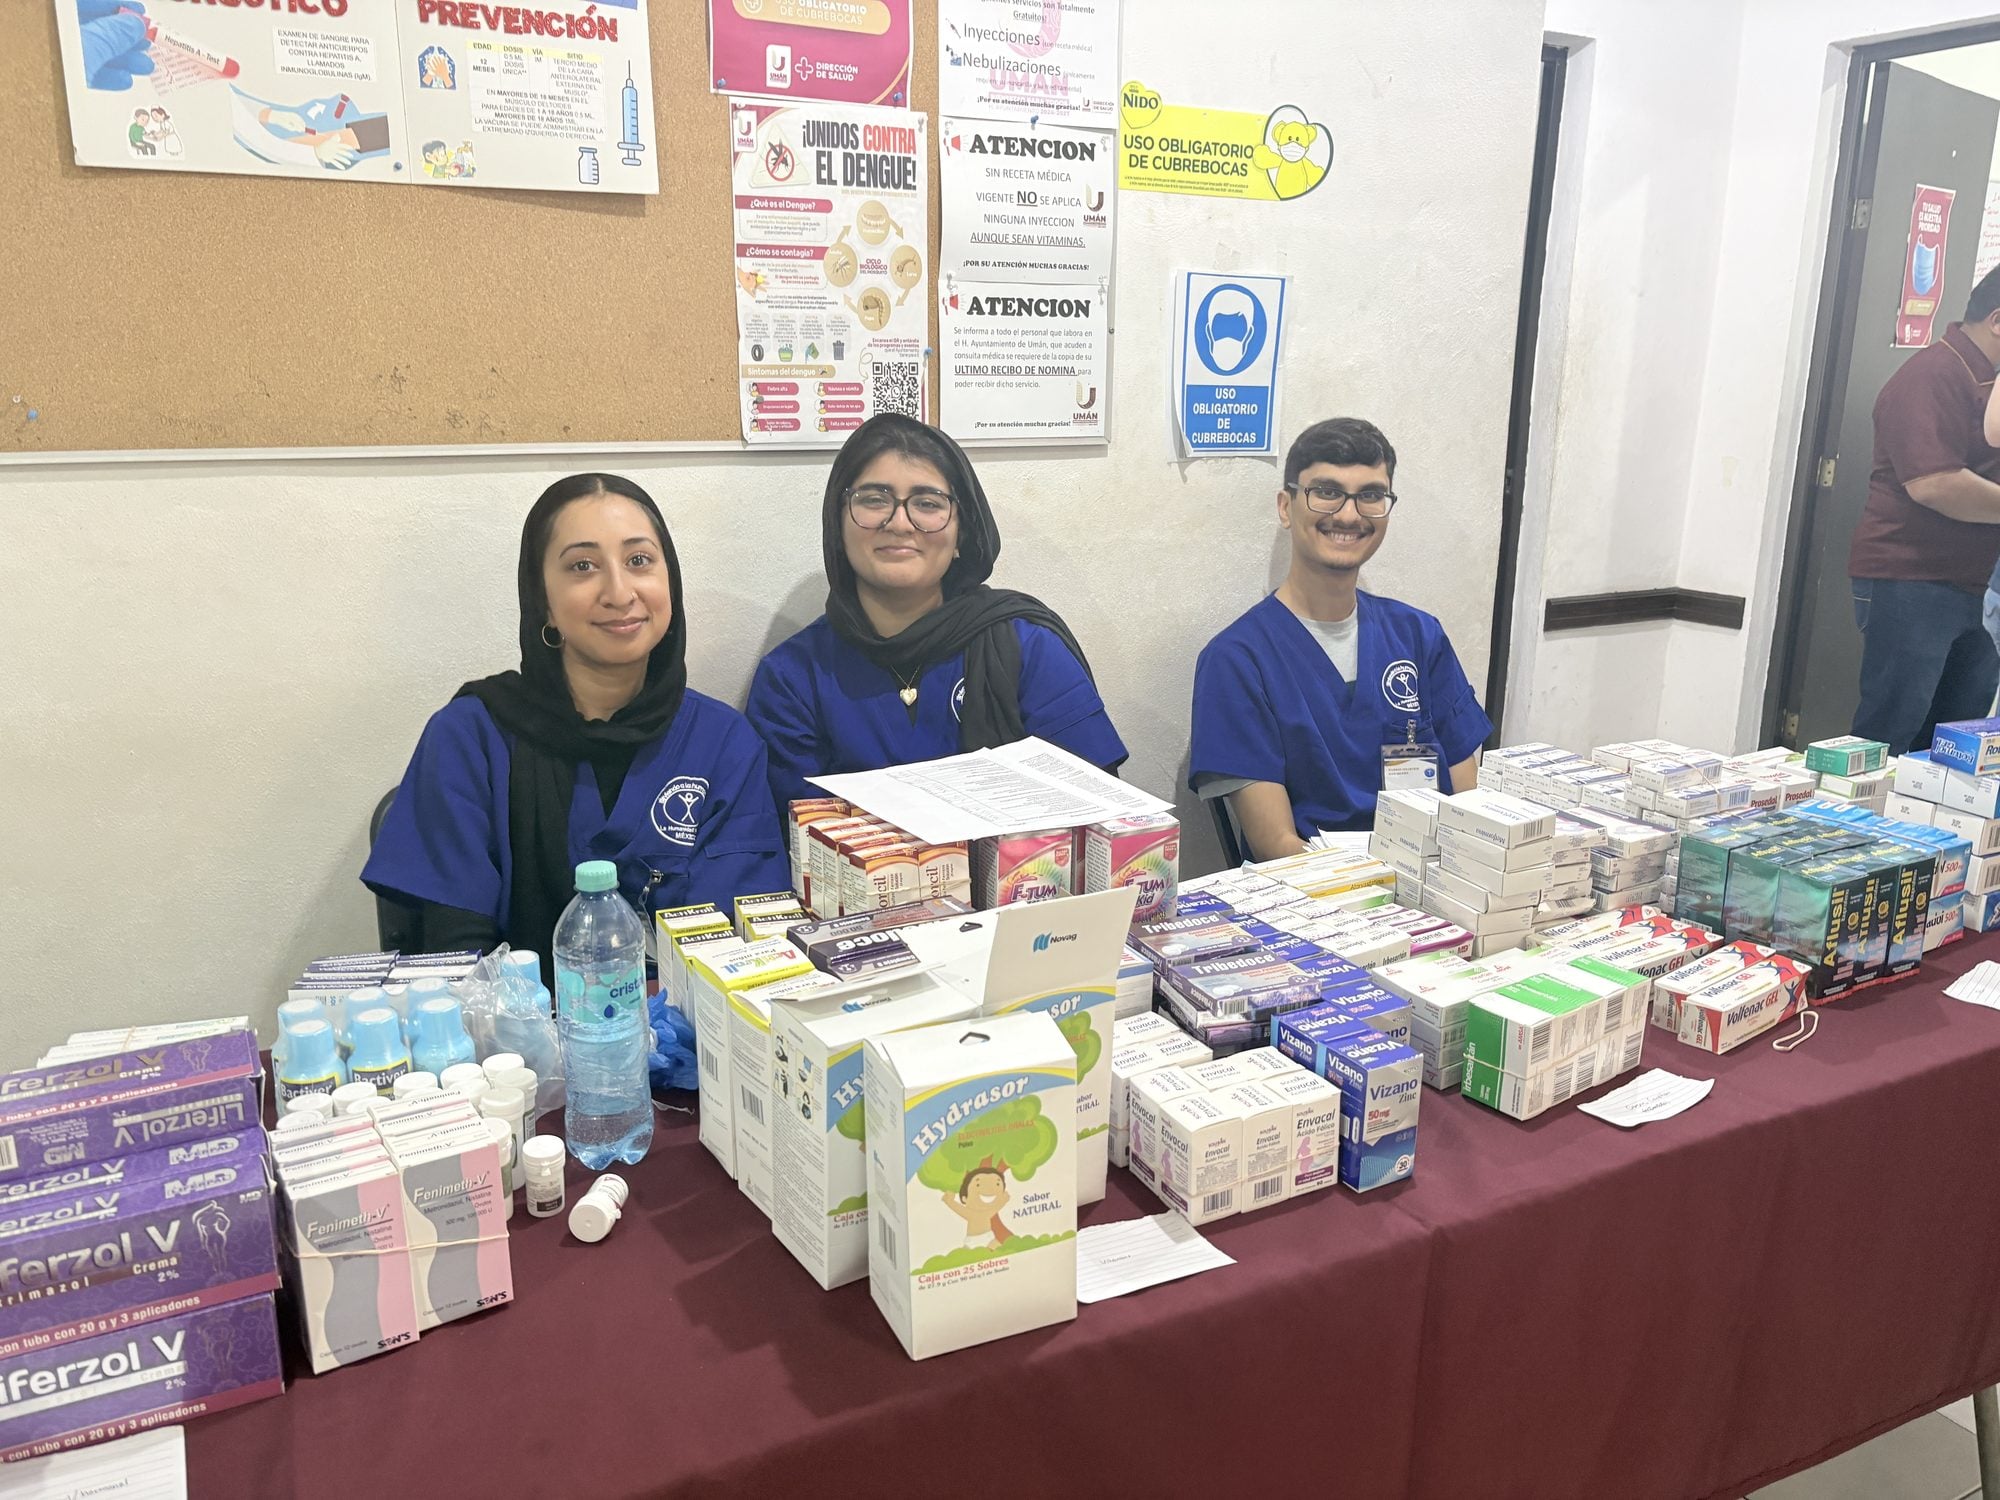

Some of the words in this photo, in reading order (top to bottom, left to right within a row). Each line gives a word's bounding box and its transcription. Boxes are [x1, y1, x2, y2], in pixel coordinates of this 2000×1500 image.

[417, 0, 618, 42] PREVENCIÓN
[780, 7, 794, 16] DE
[796, 9, 863, 25] CUBREBOCAS
[278, 29, 308, 39] EXAMEN
[309, 33, 319, 41] DE
[320, 33, 350, 44] SANGRE
[350, 36, 370, 46] PARA
[964, 23, 1041, 46] Inyecciones
[307, 60, 345, 69] LLAMADOS
[816, 62, 858, 75] DIRECCIÓN
[963, 52, 1062, 76] Nebulizaciones
[816, 71, 827, 79] DE
[828, 72, 854, 82] SALUD
[1123, 93, 1159, 110] NIDO
[802, 119, 859, 151] ¡UNIDOS
[863, 124, 917, 154] CONTRA
[970, 134, 1096, 162] ATENCION
[1124, 134, 1155, 151] USO
[1158, 137, 1254, 159] OBLIGATORIO
[816, 150, 837, 186] EL
[842, 151, 918, 191] DENGUE!
[985, 168, 1001, 178] SIN
[1002, 169, 1035, 181] RECETA
[1037, 169, 1072, 182] MÉDICA
[1129, 154, 1149, 169] DE
[1152, 155, 1248, 177] CUBREBOCAS
[750, 199, 768, 209] ¿Qué
[779, 201, 784, 209] el
[786, 201, 816, 211] Dengue?
[976, 192, 1014, 204] VIGENTE
[1017, 191, 1038, 206] NO
[1040, 196, 1050, 206] SE
[1051, 196, 1082, 208] APLICA
[983, 214, 1027, 226] NINGUNA
[1028, 216, 1075, 228] INYECCION
[1083, 214, 1107, 223] UMÁN
[970, 232, 1010, 245] AUNQUE
[1012, 234, 1035, 245] SEAN
[746, 246, 771, 257] ¿Cómo
[781, 248, 813, 259] contagia?
[963, 260, 980, 268] ¡POR
[993, 260, 1027, 270] ATENCIÓN
[1028, 262, 1057, 271] MUCHAS
[1058, 263, 1090, 271] GRACIAS!
[966, 296, 1091, 318] ATENCION
[954, 327, 962, 335] Se
[963, 327, 989, 336] informa
[996, 328, 1011, 336] todo
[1013, 328, 1020, 336] el
[1021, 328, 1049, 338] personal
[1050, 330, 1062, 339] que
[1063, 329, 1083, 337] labora
[1084, 330, 1093, 338] en
[779, 367, 789, 376] del
[790, 368, 816, 379] dengue
[954, 365, 989, 375] ULTIMO
[991, 365, 1023, 375] RECIBO
[1025, 366, 1035, 375] DE
[1038, 366, 1076, 376] NOMINA
[1078, 368, 1091, 378] para
[954, 380, 973, 389] poder
[975, 379, 995, 389] recibir
[996, 379, 1013, 389] dicho
[1015, 380, 1041, 389] servicio.
[1215, 388, 1236, 399] USO
[1073, 411, 1098, 420] UMÁN
[1193, 403, 1258, 415] OBLIGATORIO
[1217, 418, 1231, 429] DE
[1192, 432, 1257, 444] CUBREBOCAS
[741, 893, 790, 904] ActiKroll
[873, 875, 889, 908] orcil
[664, 906, 715, 919] ActiKroll
[752, 912, 804, 922] ActiKroll
[1892, 870, 1914, 946] Aflusil
[1141, 911, 1221, 934] Tribedoce
[1824, 889, 1845, 968] Aflusil
[681, 930, 734, 944] ActiKroll
[1048, 931, 1078, 946] Novag
[1570, 934, 1612, 950] Volfenac
[1611, 929, 1630, 939] GEL
[1601, 945, 1645, 962] Volfenac
[1643, 941, 1663, 950] GEL
[1192, 953, 1276, 976] Tribedoce
[1667, 964, 1706, 982] Volfenac
[1702, 957, 1721, 967] GEL
[1700, 979, 1738, 998] Volfenac
[1736, 972, 1756, 982] GEL
[1331, 987, 1386, 1006] Vizano
[1726, 1000, 1765, 1027] Volfenac
[1765, 990, 1779, 1008] GEL
[1280, 1026, 1313, 1055] Vizano
[1327, 1053, 1364, 1082] Vizano
[1370, 1078, 1418, 1101] Vizano
[1398, 1091, 1417, 1104] Zinc
[912, 1075, 1030, 1155] Hydrasor
[1131, 1097, 1157, 1125] Envacal
[1297, 1108, 1336, 1130] Envacal
[142, 1102, 245, 1142] Liferzol
[1316, 1122, 1335, 1133] Fólico
[114, 1127, 136, 1148] V
[1257, 1131, 1281, 1146] Envacal
[169, 1137, 240, 1166] MD
[1205, 1144, 1231, 1159] Envacal
[1399, 1160, 1408, 1170] 30
[413, 1171, 490, 1204] Fenimeth-V
[1023, 1191, 1051, 1205] Sabor
[1012, 1199, 1062, 1219] NATURAL
[307, 1204, 390, 1239] Fenimeth-V
[0, 1231, 134, 1291] ferzol
[145, 1219, 181, 1254] V
[132, 1255, 178, 1275] Crema
[918, 1273, 941, 1285] Caja
[943, 1269, 961, 1280] con
[963, 1265, 976, 1275] 25
[978, 1257, 1010, 1272] Sobres
[157, 1270, 180, 1283] 2%
[0, 1341, 142, 1403] iferzol
[152, 1330, 186, 1363] V
[8, 1448, 31, 1463] con
[33, 1440, 61, 1457] tubo
[64, 1434, 86, 1449] con
[89, 1428, 104, 1442] 20
[107, 1426, 116, 1439] g
[118, 1424, 127, 1436] y
[129, 1419, 138, 1430] 3
[140, 1401, 207, 1429] aplicadores
